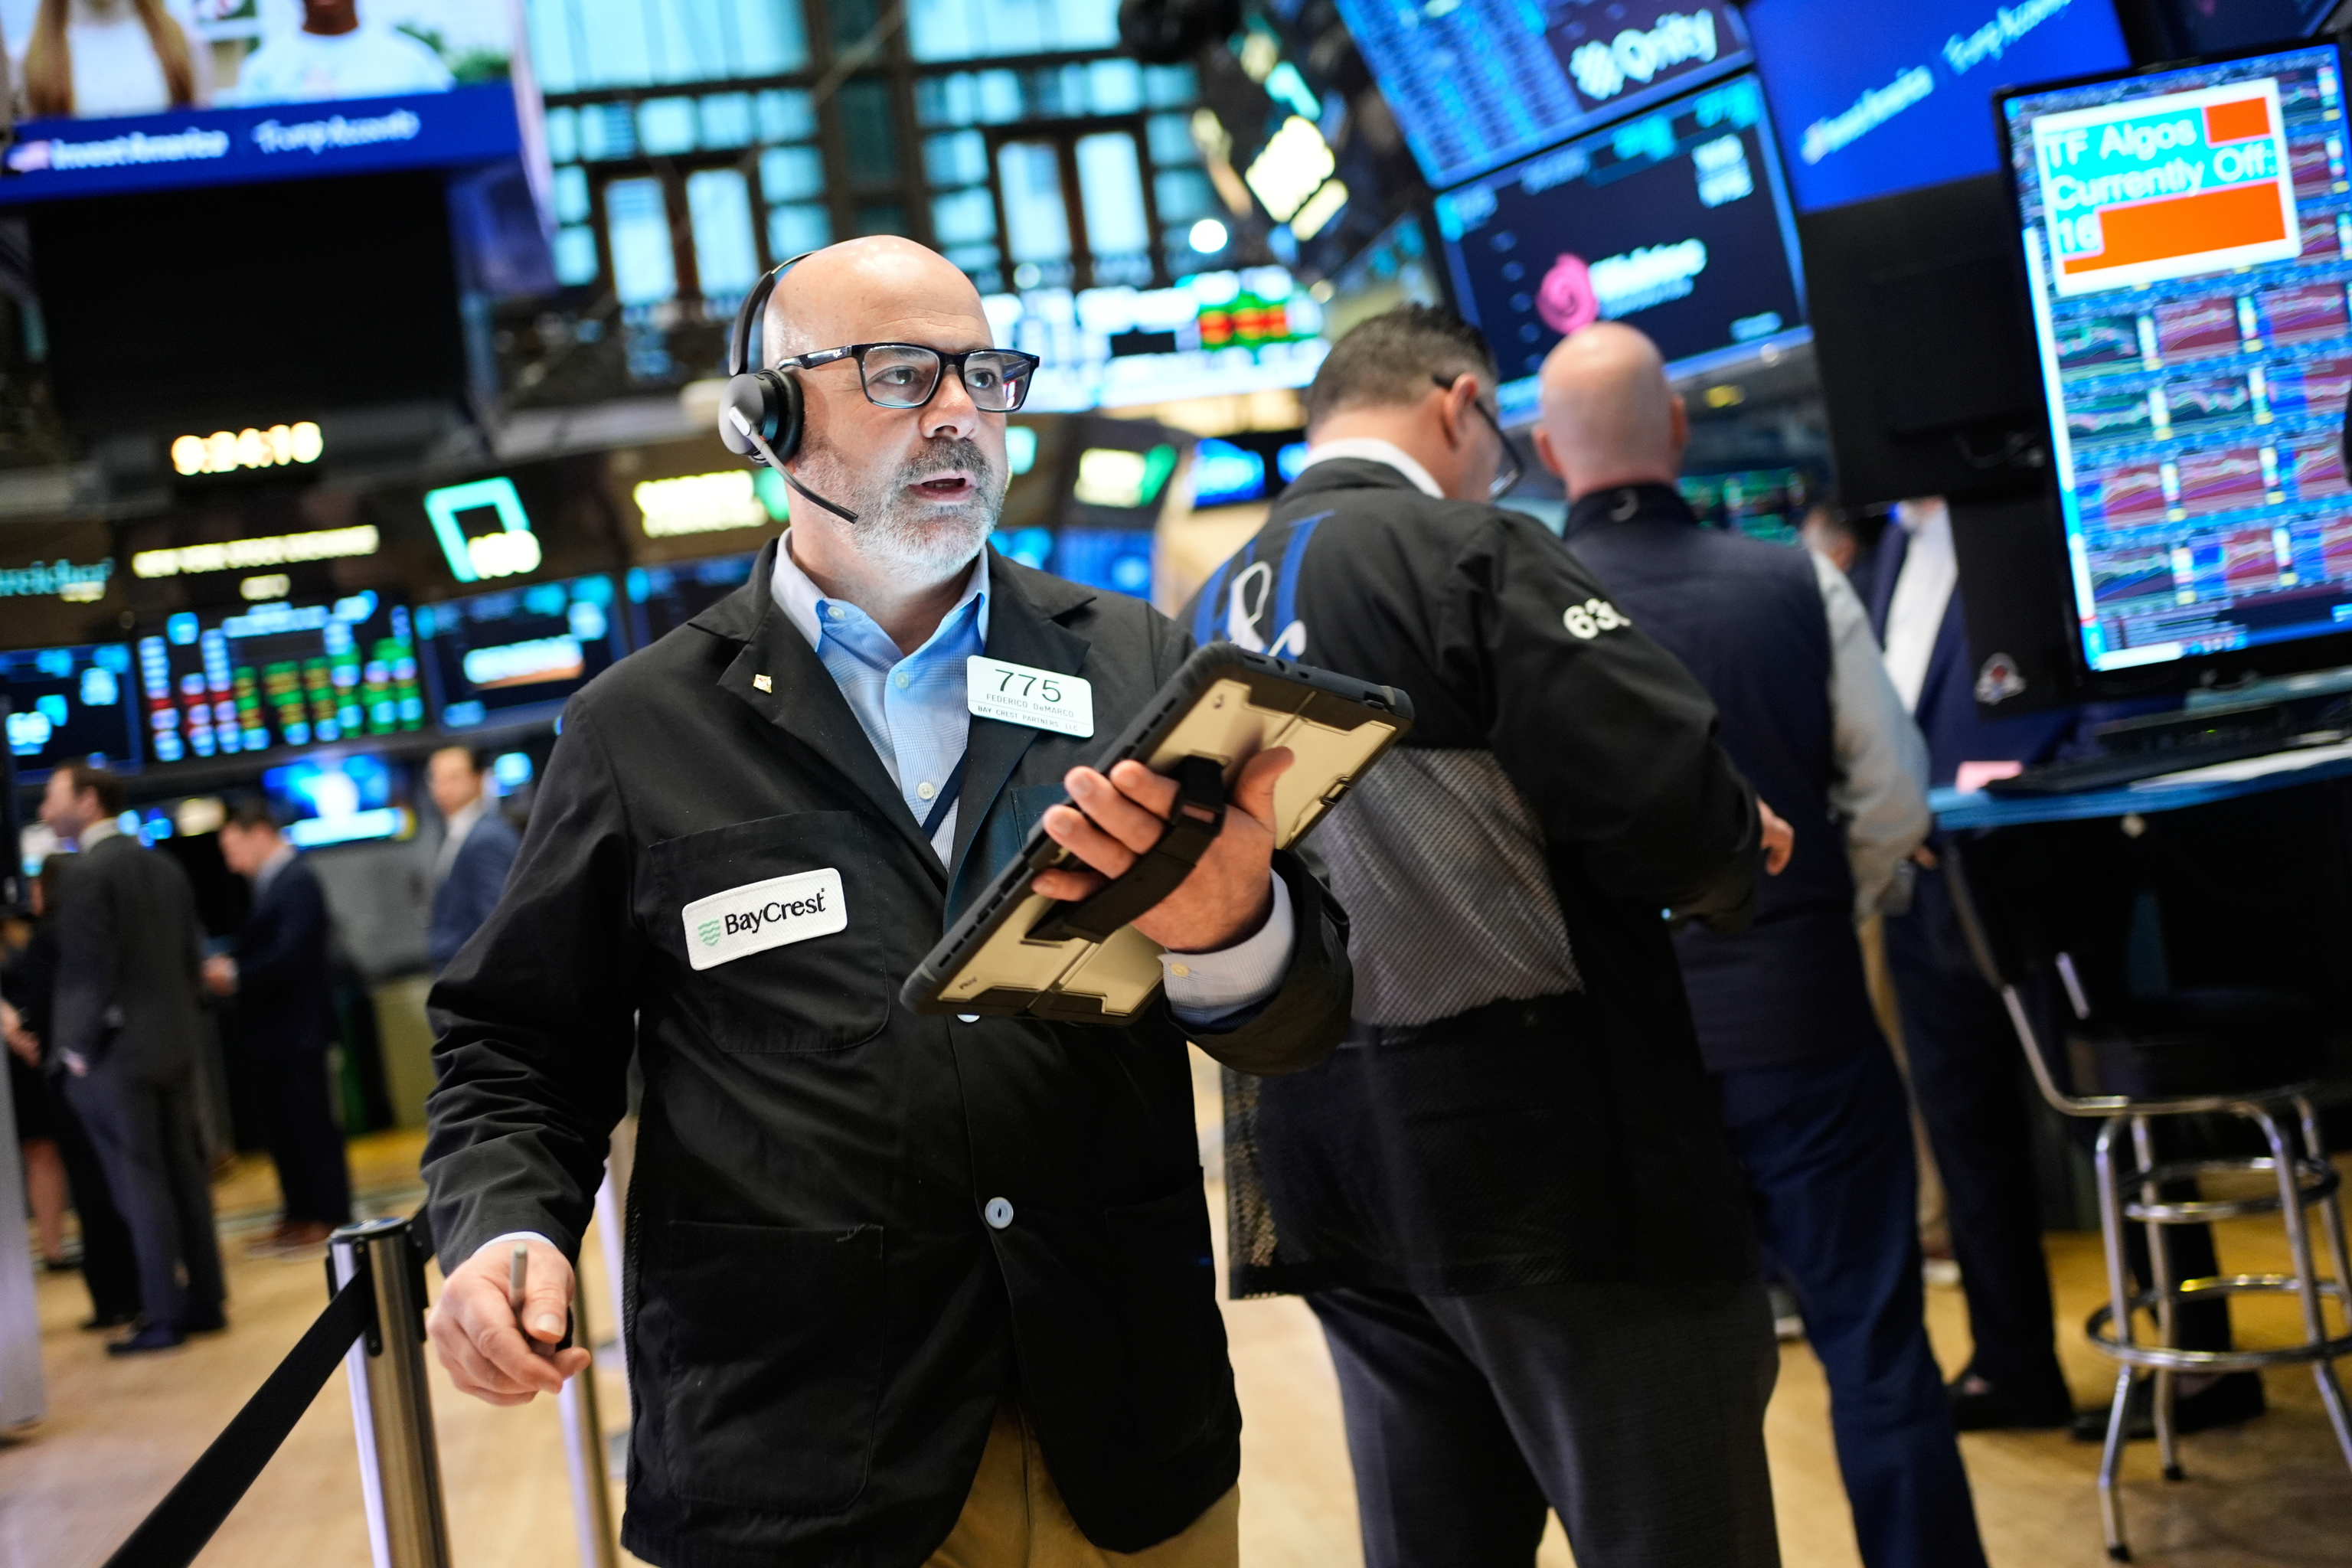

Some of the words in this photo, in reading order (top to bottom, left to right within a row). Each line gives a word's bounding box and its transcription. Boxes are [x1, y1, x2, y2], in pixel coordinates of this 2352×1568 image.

[2046, 128, 2089, 169] TF
[2099, 118, 2197, 162] Algos
[2052, 156, 2206, 210] Currently
[995, 668, 1061, 703] 775
[978, 705, 992, 714] BAY
[996, 709, 1018, 719] CREST
[1065, 724, 1078, 732] LLC
[986, 693, 1027, 708] FEDERICO
[1033, 703, 1074, 718] DeMARCO
[724, 892, 826, 936] BayCrest
